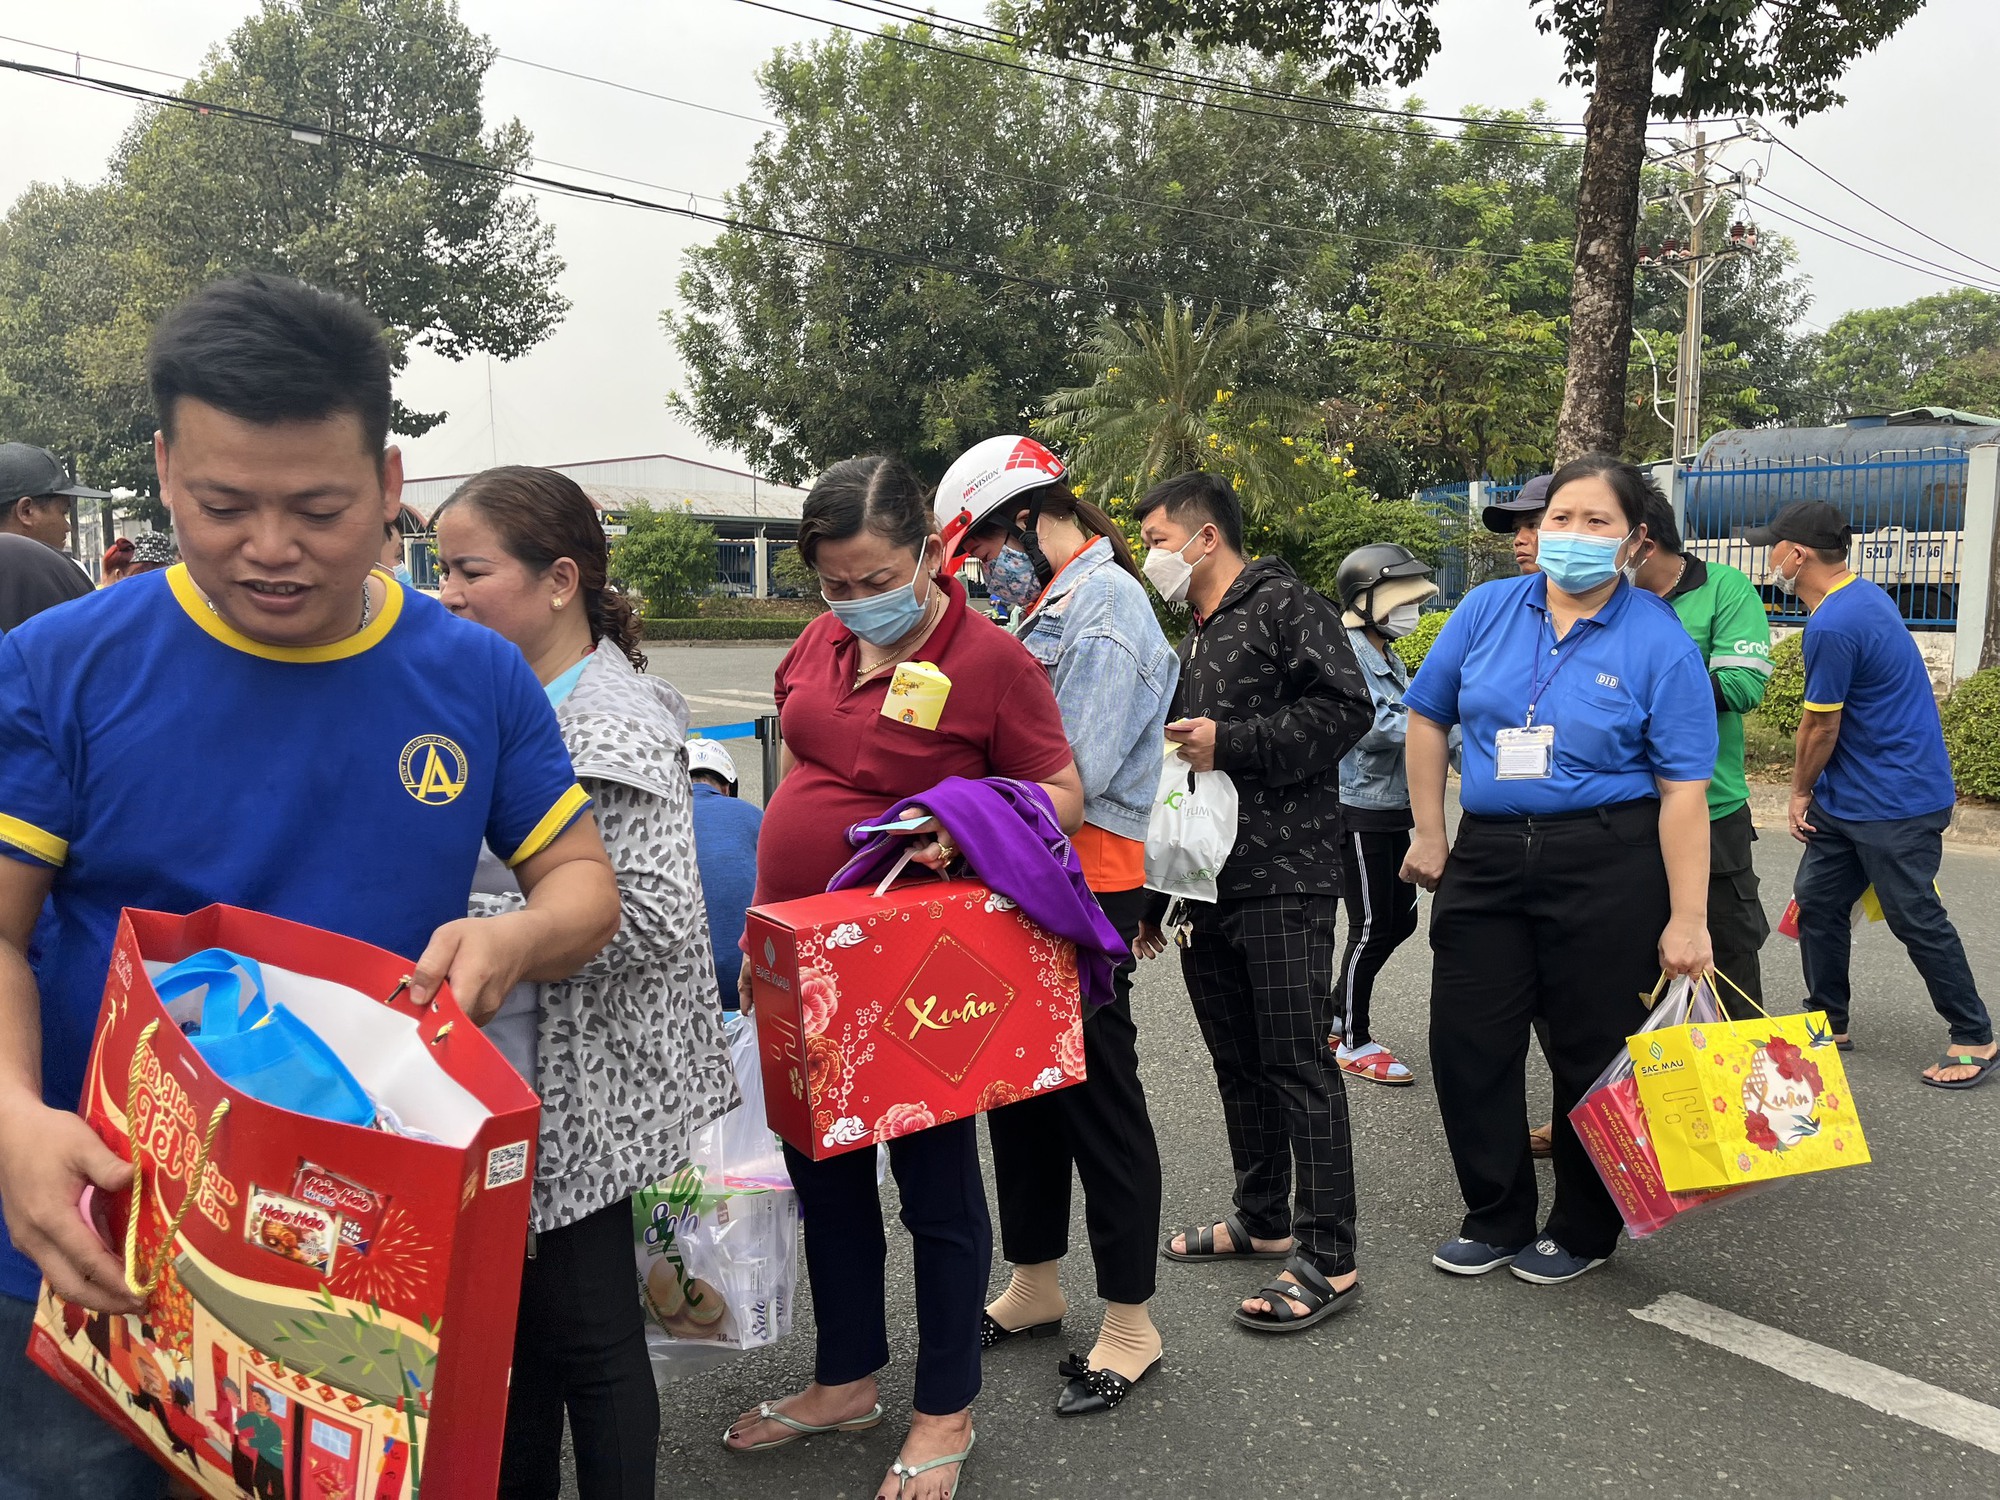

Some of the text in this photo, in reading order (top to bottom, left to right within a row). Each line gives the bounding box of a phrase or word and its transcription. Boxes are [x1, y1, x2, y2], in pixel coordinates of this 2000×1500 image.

[963, 467, 1000, 499] HIKVISION
[1733, 640, 1769, 657] Grab
[1599, 675, 1617, 687] DID
[905, 992, 997, 1041] Xuân
[1641, 1064, 1659, 1075] SAC
[1662, 1059, 1684, 1070] MAU
[1748, 1083, 1810, 1114] Xuân
[133, 1083, 183, 1179] Tết
[305, 1177, 372, 1212] Hảo Hảo
[259, 1203, 326, 1232] Hảo Hảo
